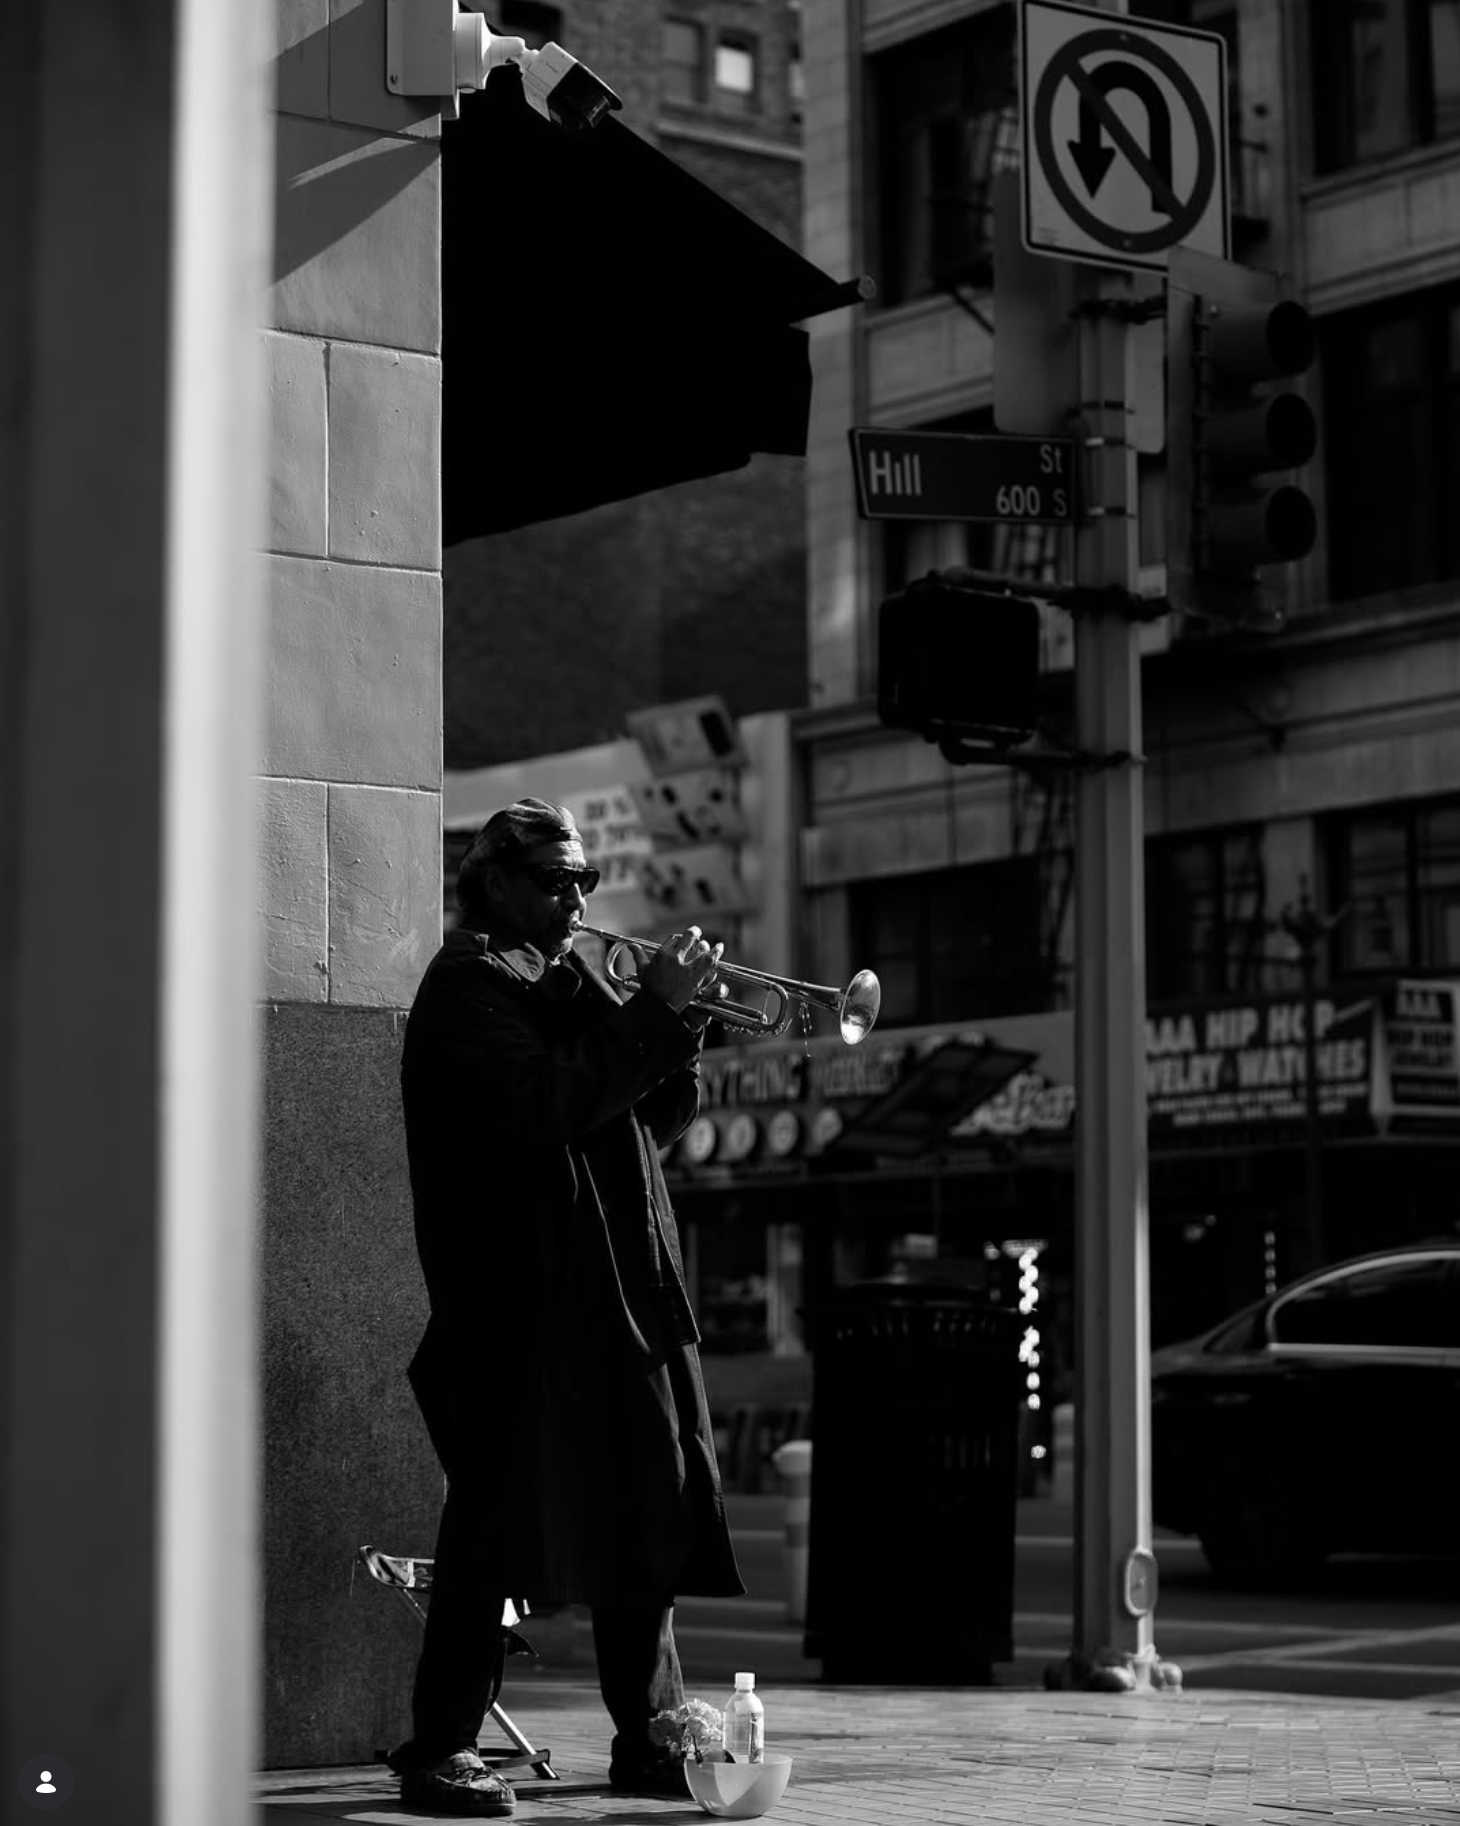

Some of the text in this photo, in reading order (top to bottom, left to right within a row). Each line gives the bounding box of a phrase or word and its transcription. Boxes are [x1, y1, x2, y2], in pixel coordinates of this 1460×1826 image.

[869, 444, 1063, 496] Hill St
[996, 485, 1068, 517] 600 S
[1205, 1008, 1259, 1050] HIP
